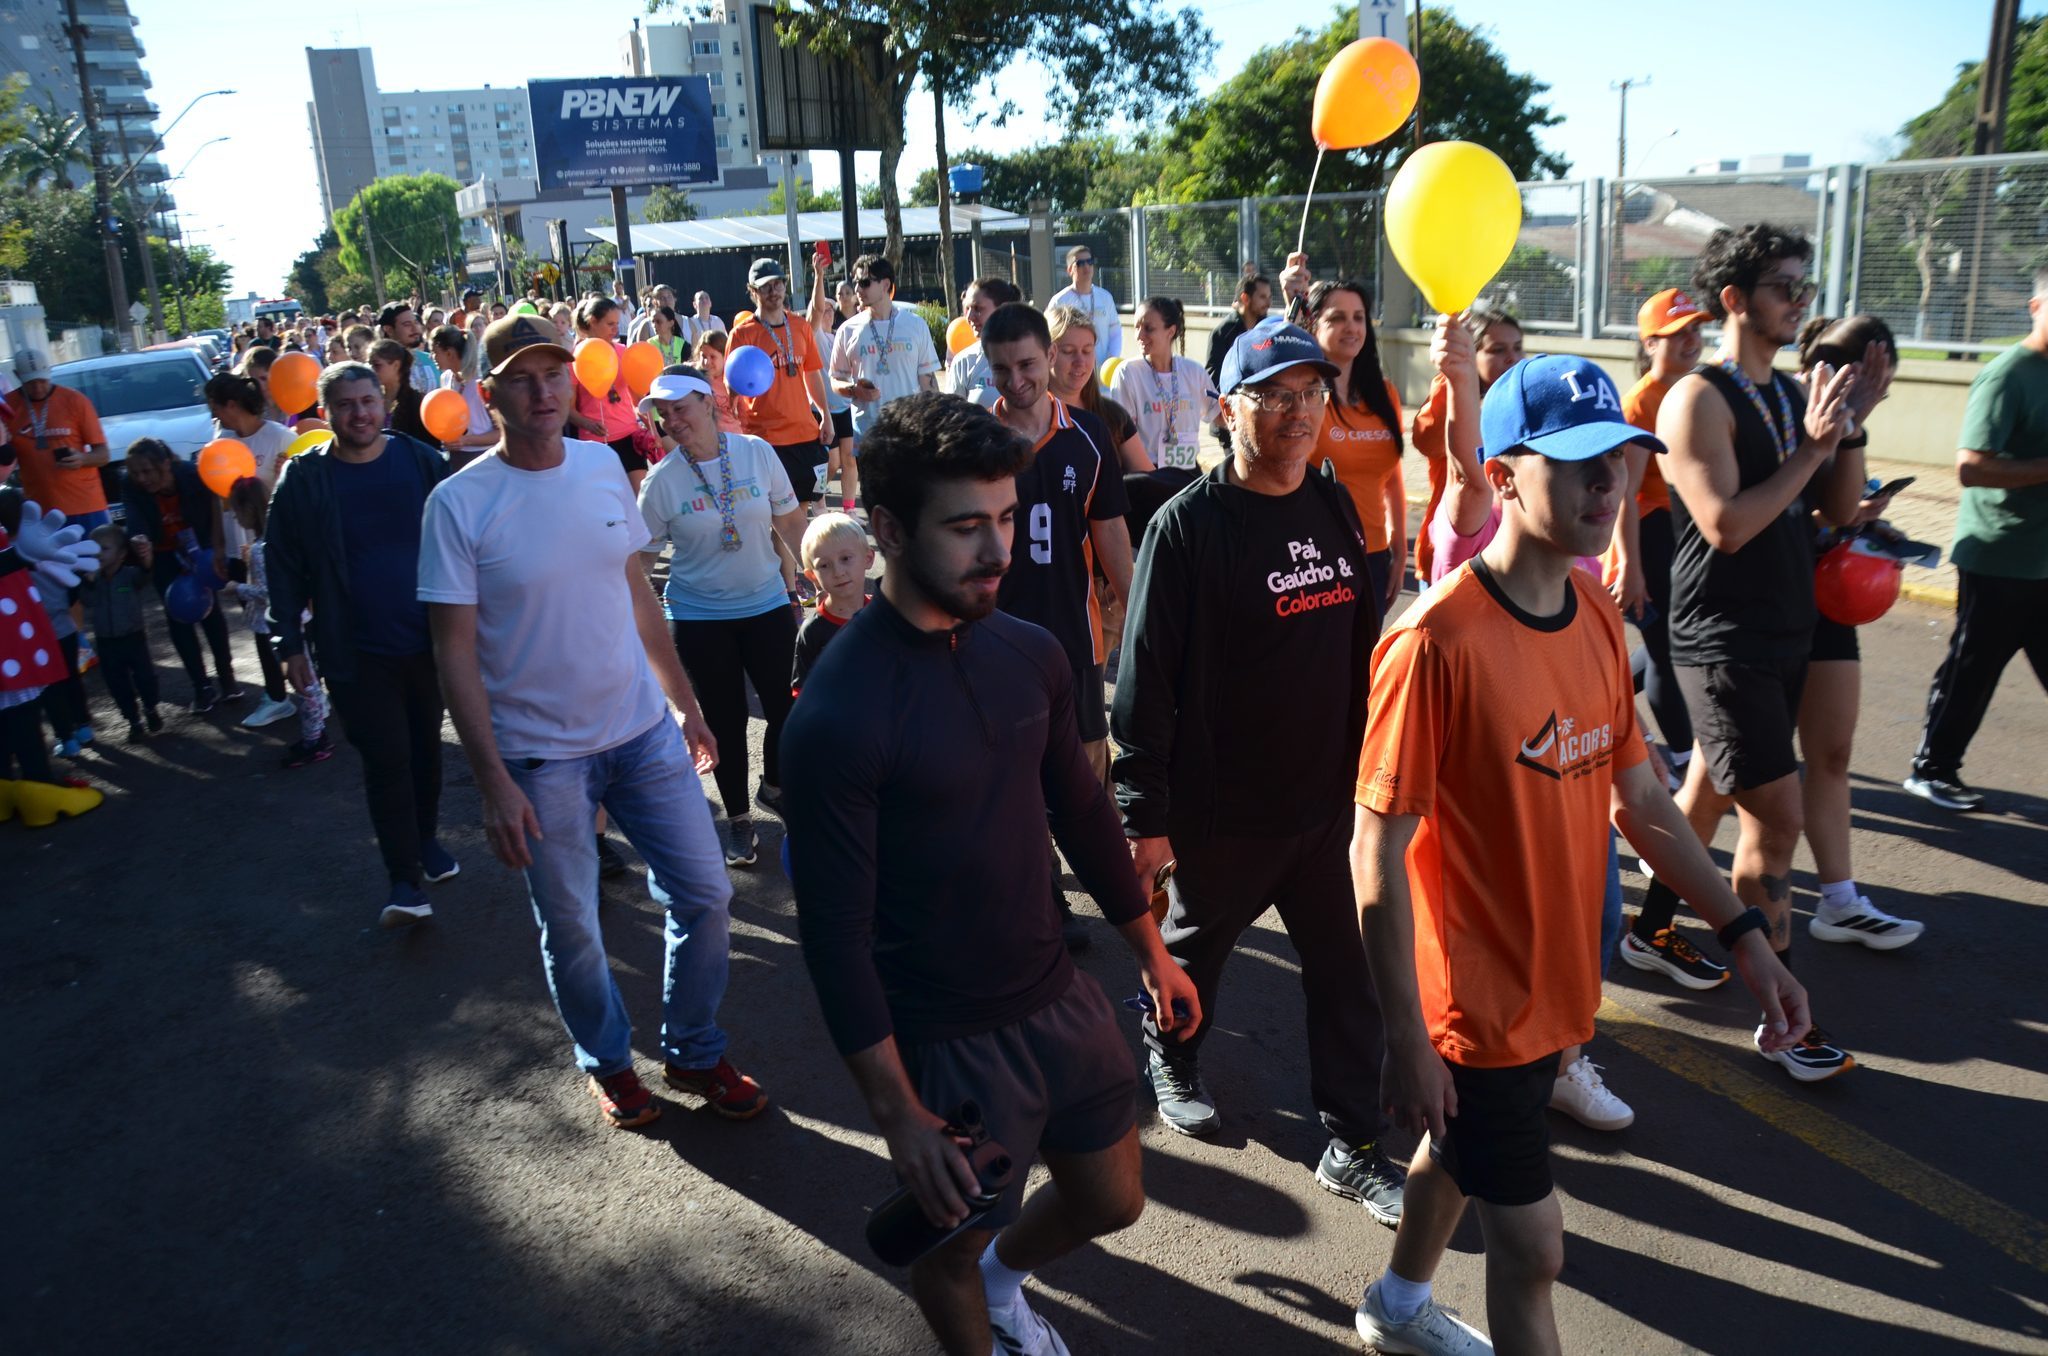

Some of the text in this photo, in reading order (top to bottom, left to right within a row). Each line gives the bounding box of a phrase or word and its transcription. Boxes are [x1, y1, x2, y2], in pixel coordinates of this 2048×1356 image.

[560, 86, 682, 119] PBNEW
[591, 117, 685, 132] SISTEMAS
[585, 137, 667, 150] Soluções tecnológicas
[586, 148, 598, 157] em
[599, 147, 631, 157] produtos
[663, 162, 701, 173] 3744-3880
[1560, 369, 1620, 412] LA
[1164, 445, 1195, 466] 552
[1029, 502, 1052, 565] 9
[1287, 537, 1321, 562] Pai,
[1267, 557, 1354, 593] Gaúcho &
[1275, 581, 1355, 617] Colorado.
[1559, 723, 1613, 767] ACORS
